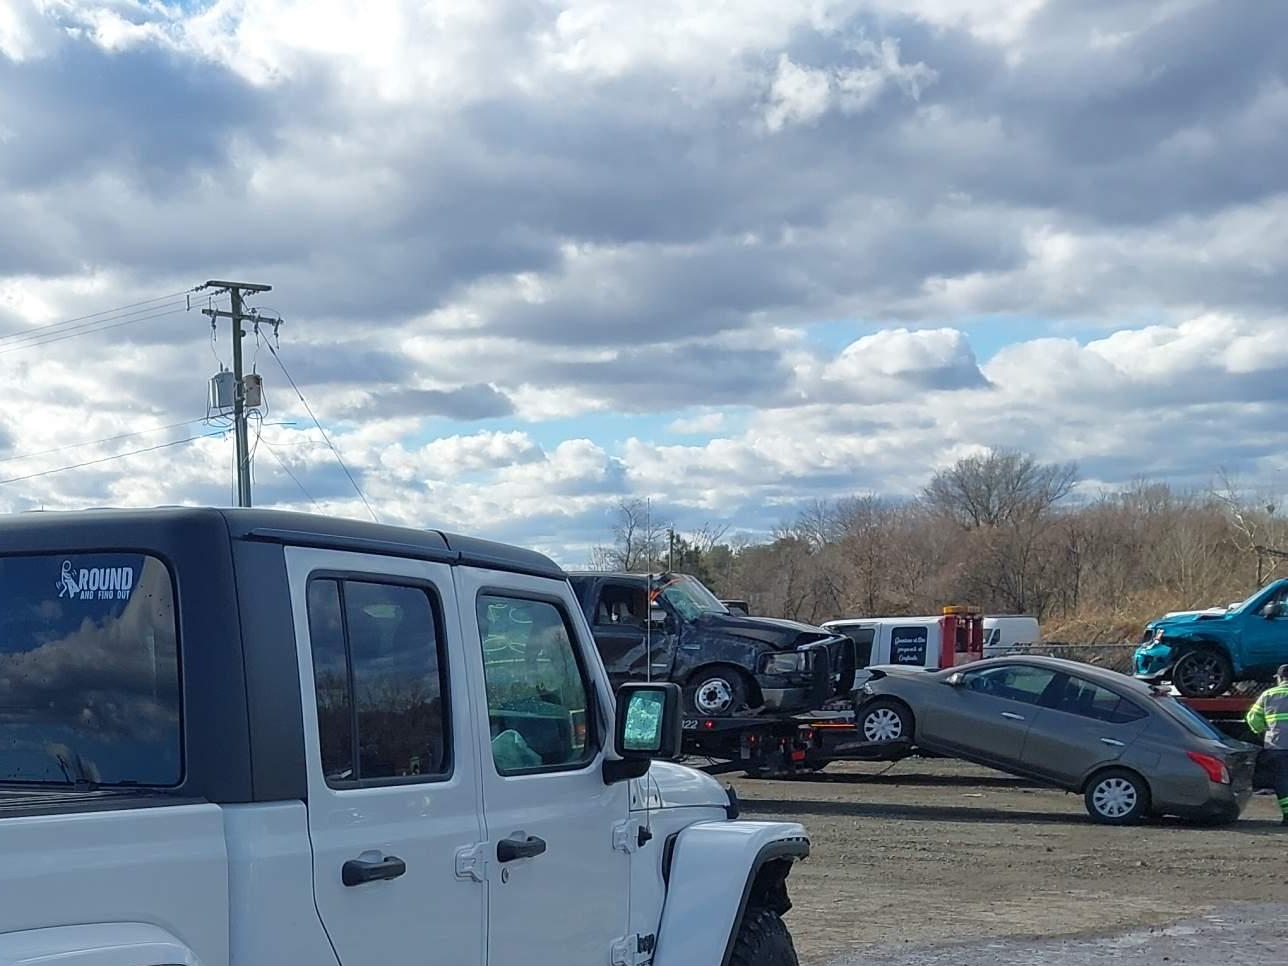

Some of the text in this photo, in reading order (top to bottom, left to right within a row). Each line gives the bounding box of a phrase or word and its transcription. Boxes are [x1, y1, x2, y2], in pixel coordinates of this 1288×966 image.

[78, 567, 133, 591] ROUND
[79, 590, 130, 600] AND FIND OUT
